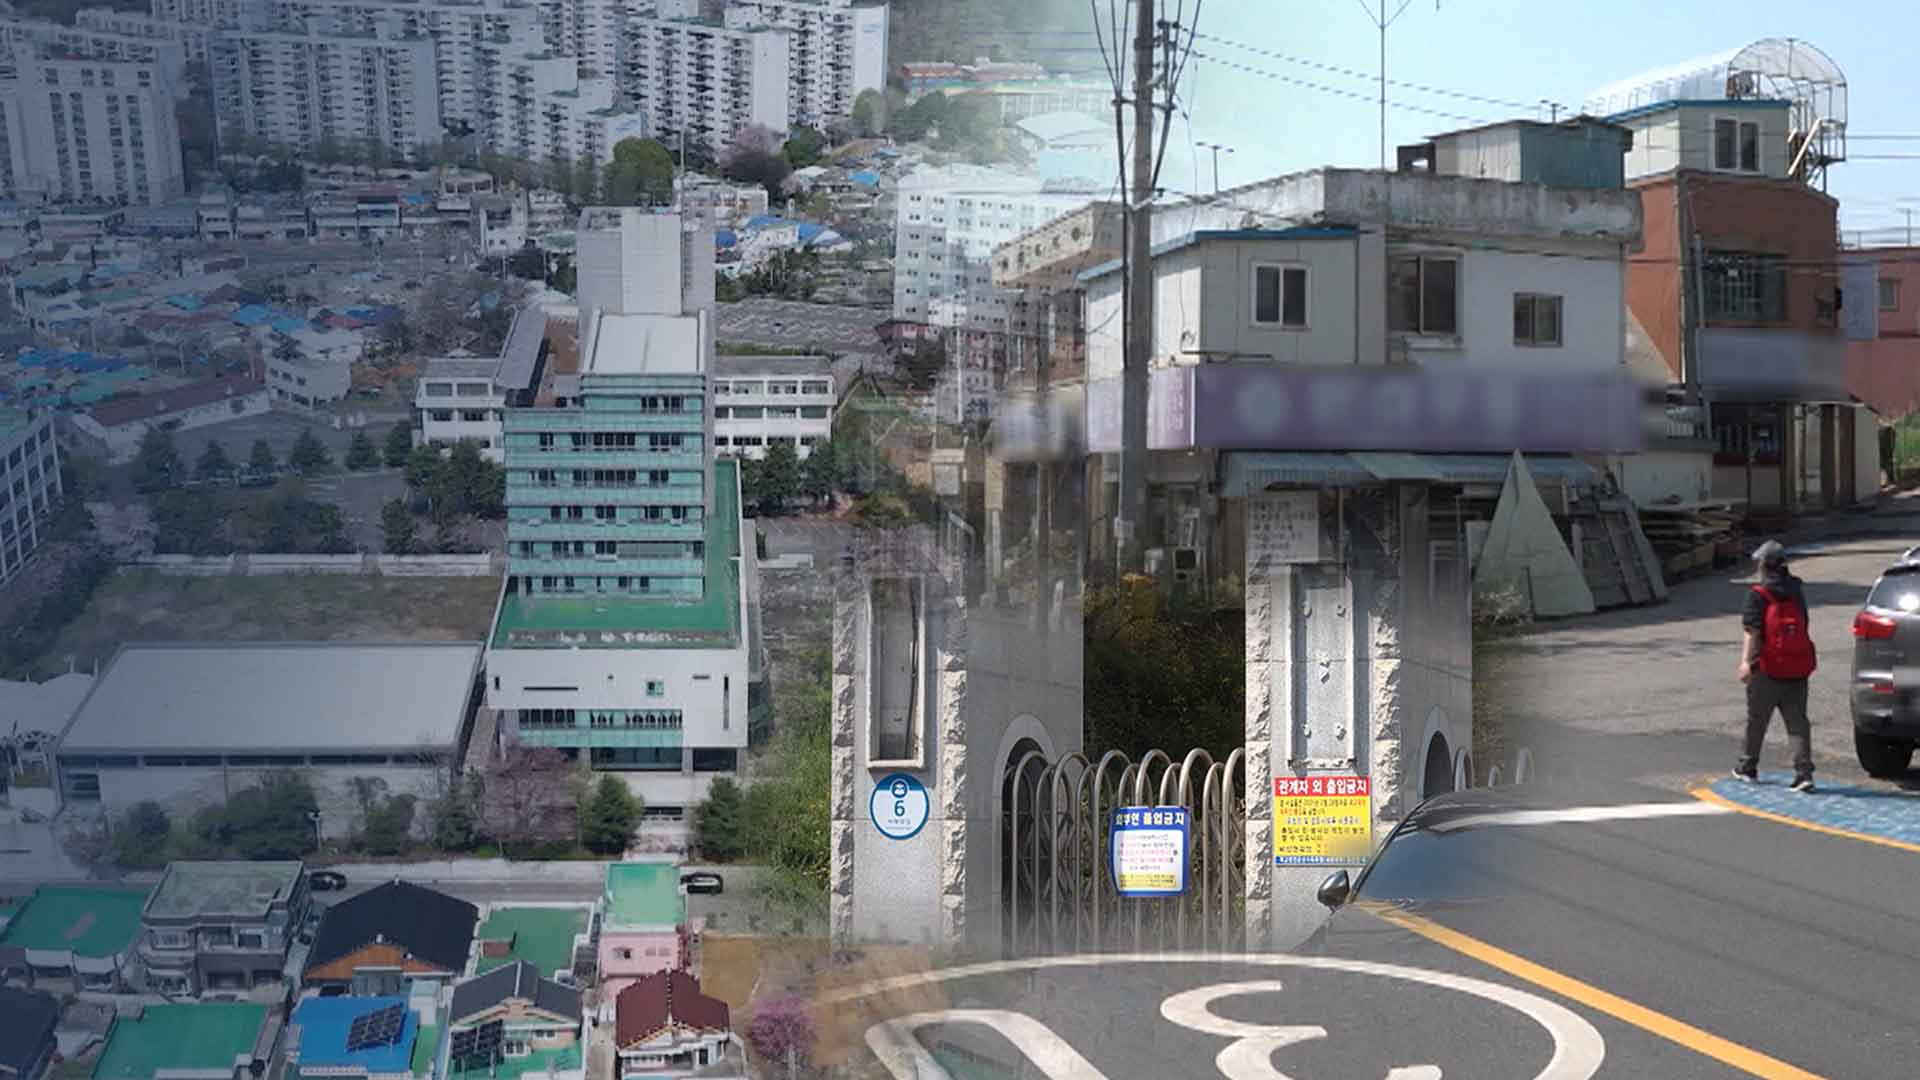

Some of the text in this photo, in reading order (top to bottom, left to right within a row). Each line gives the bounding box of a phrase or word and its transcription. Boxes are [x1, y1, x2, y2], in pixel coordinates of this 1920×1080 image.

[1279, 779, 1367, 794] 관계자 외 출입금지
[894, 800, 905, 817] 6
[1115, 812, 1185, 826] 외부인 출입금지
